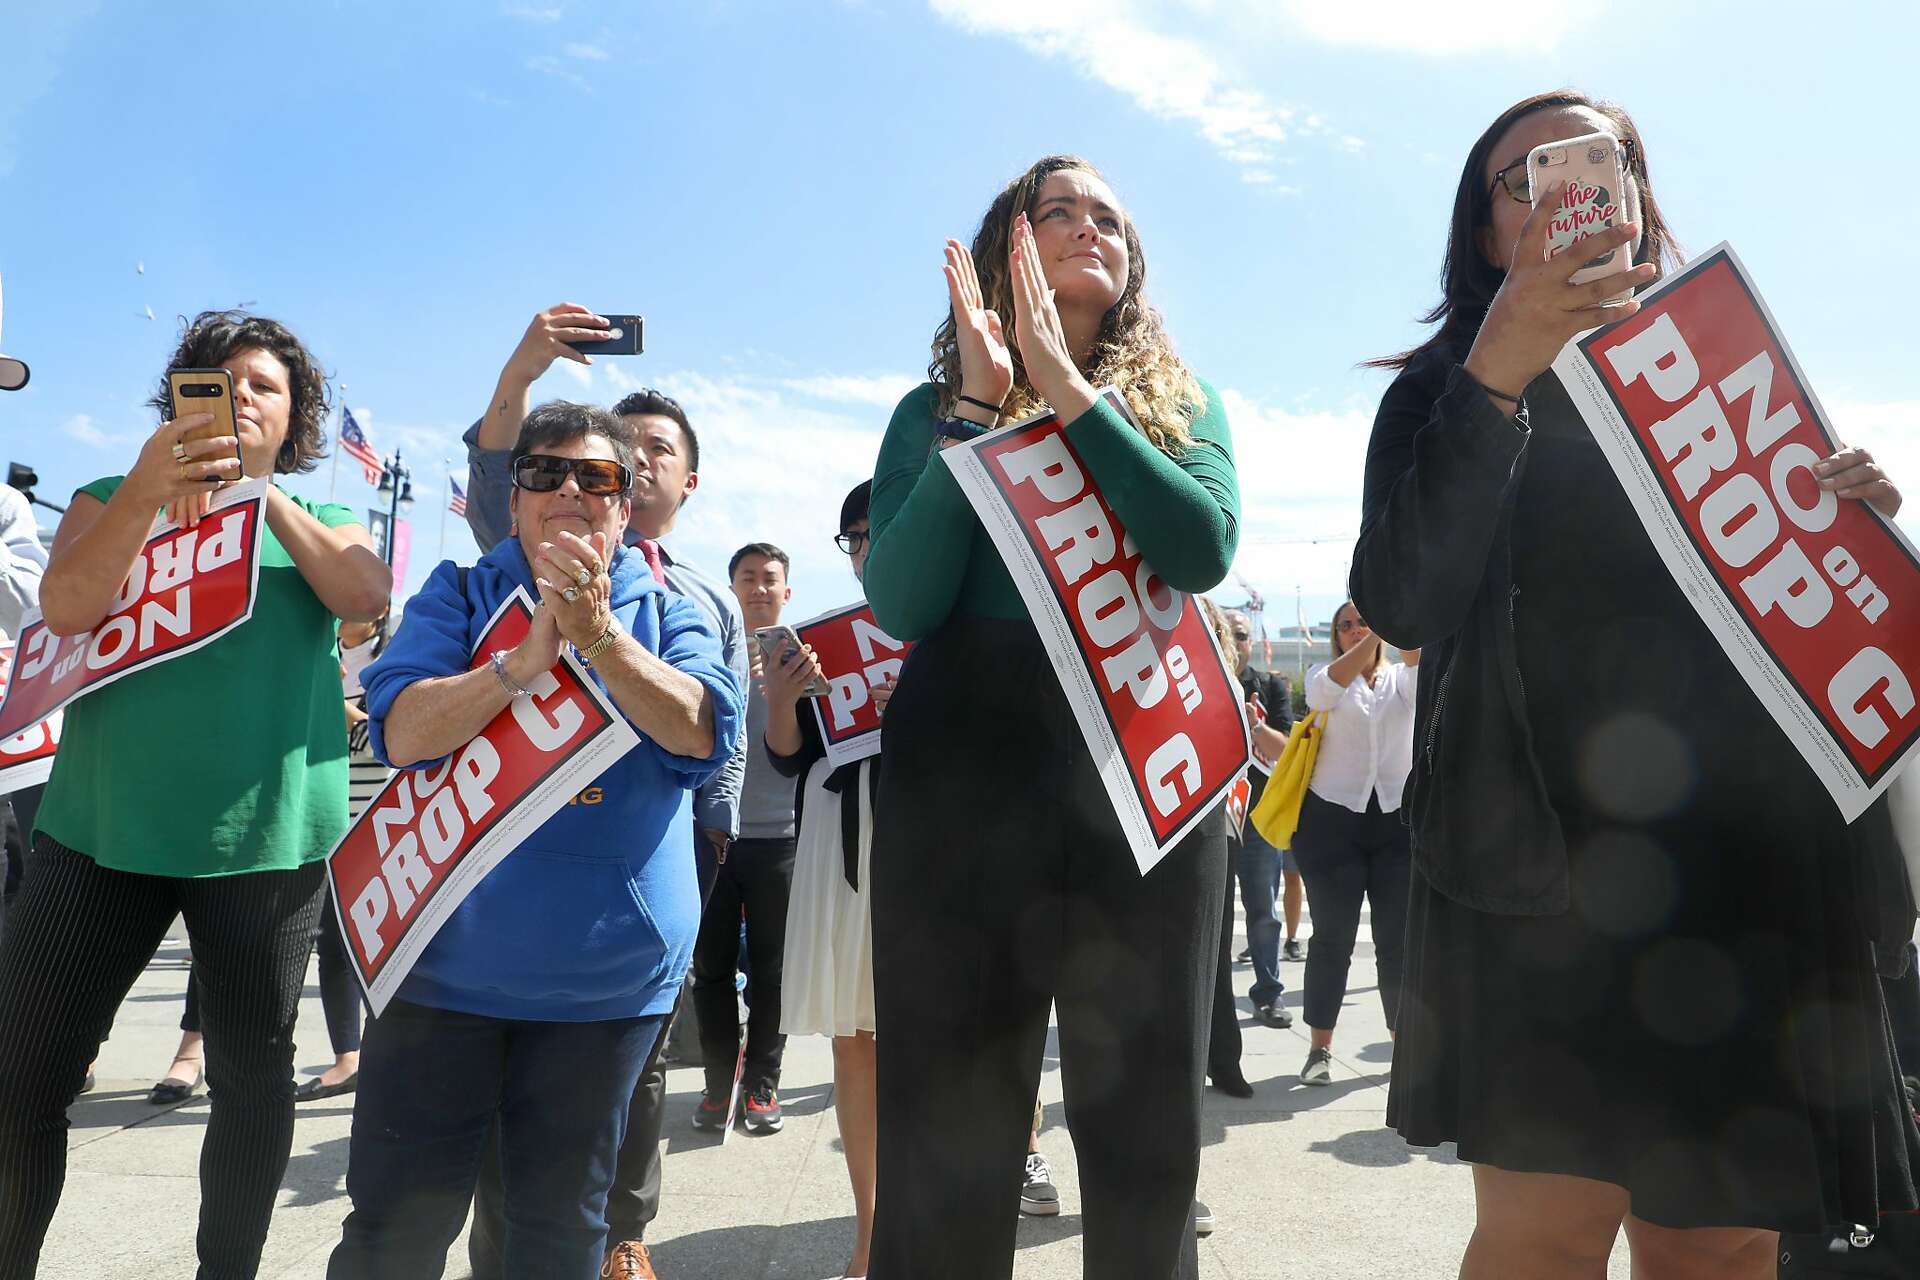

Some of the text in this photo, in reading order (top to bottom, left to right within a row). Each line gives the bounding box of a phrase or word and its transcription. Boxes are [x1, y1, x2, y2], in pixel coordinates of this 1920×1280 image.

[75, 511, 246, 644] PRO
[1604, 312, 1916, 750] PROP C
[1718, 350, 1890, 624] NO on
[51, 585, 191, 685] NO on
[996, 432, 1169, 709] PROP
[1144, 732, 1202, 818] C
[1165, 644, 1203, 715] on
[350, 735, 501, 965] PROP
[511, 671, 585, 752] C
